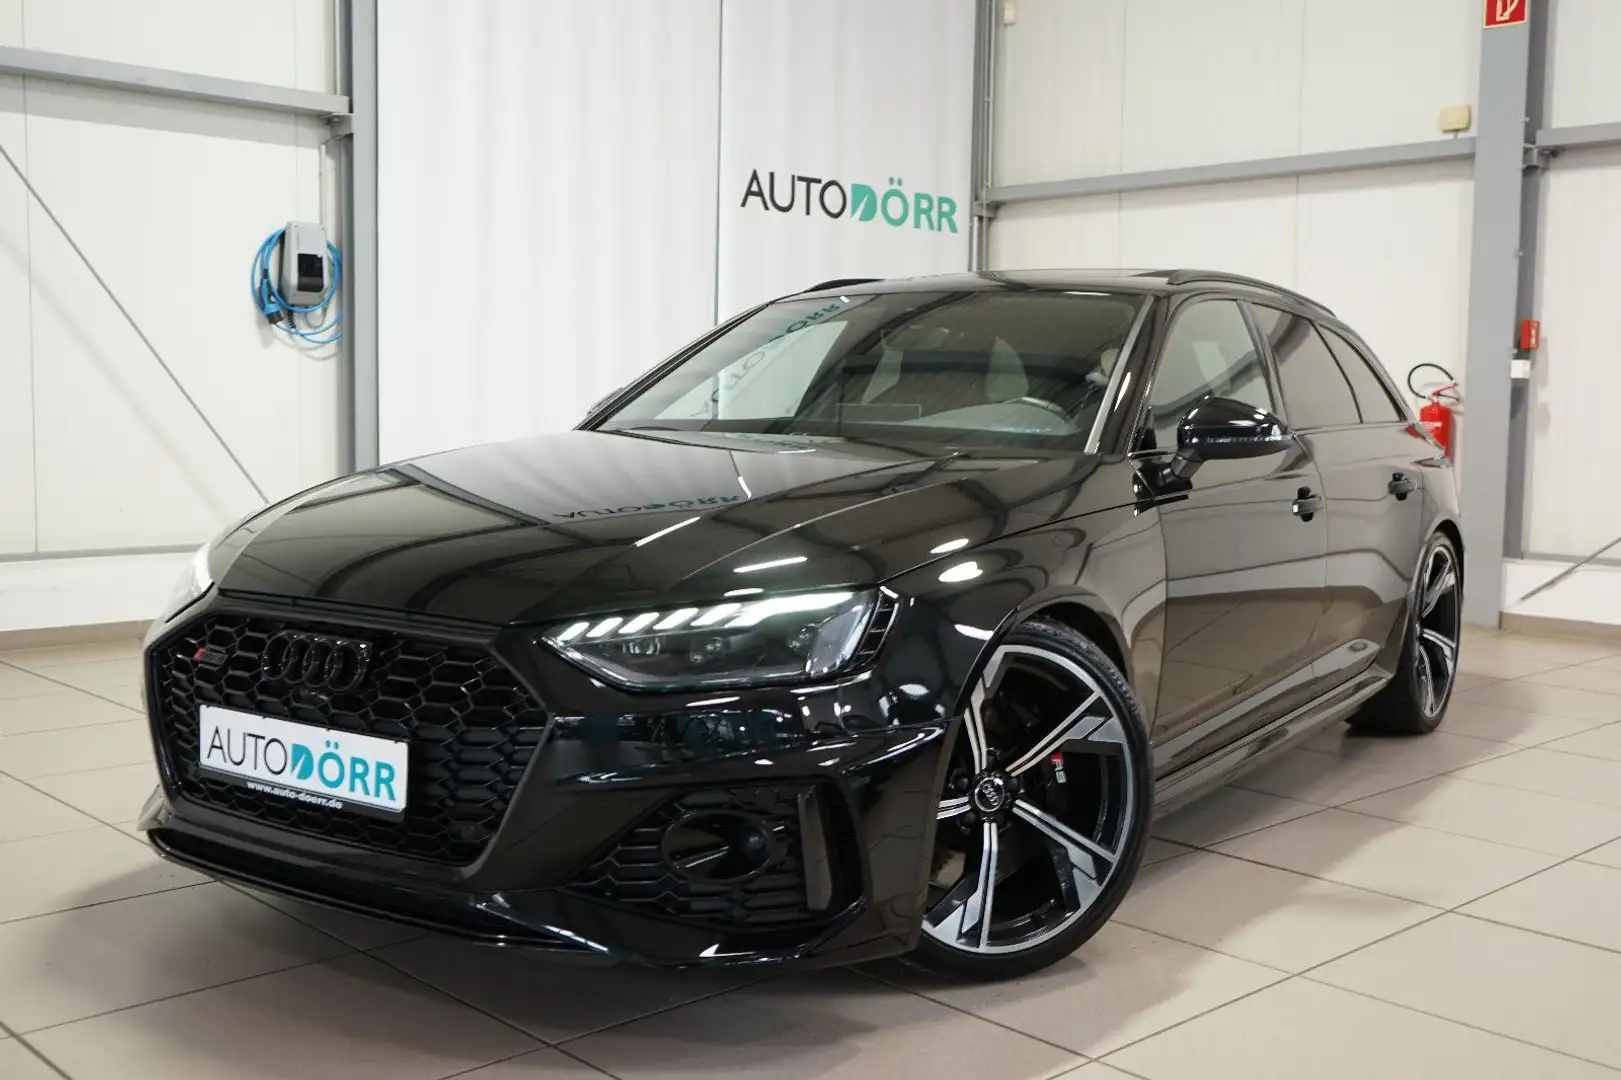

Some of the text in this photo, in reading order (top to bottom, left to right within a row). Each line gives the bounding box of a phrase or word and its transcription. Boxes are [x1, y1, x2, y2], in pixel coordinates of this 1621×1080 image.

[740, 168, 958, 233] AUTODÖRR
[207, 725, 396, 801] AUTODÖRR
[247, 781, 343, 809] www.auto-doerr.de
